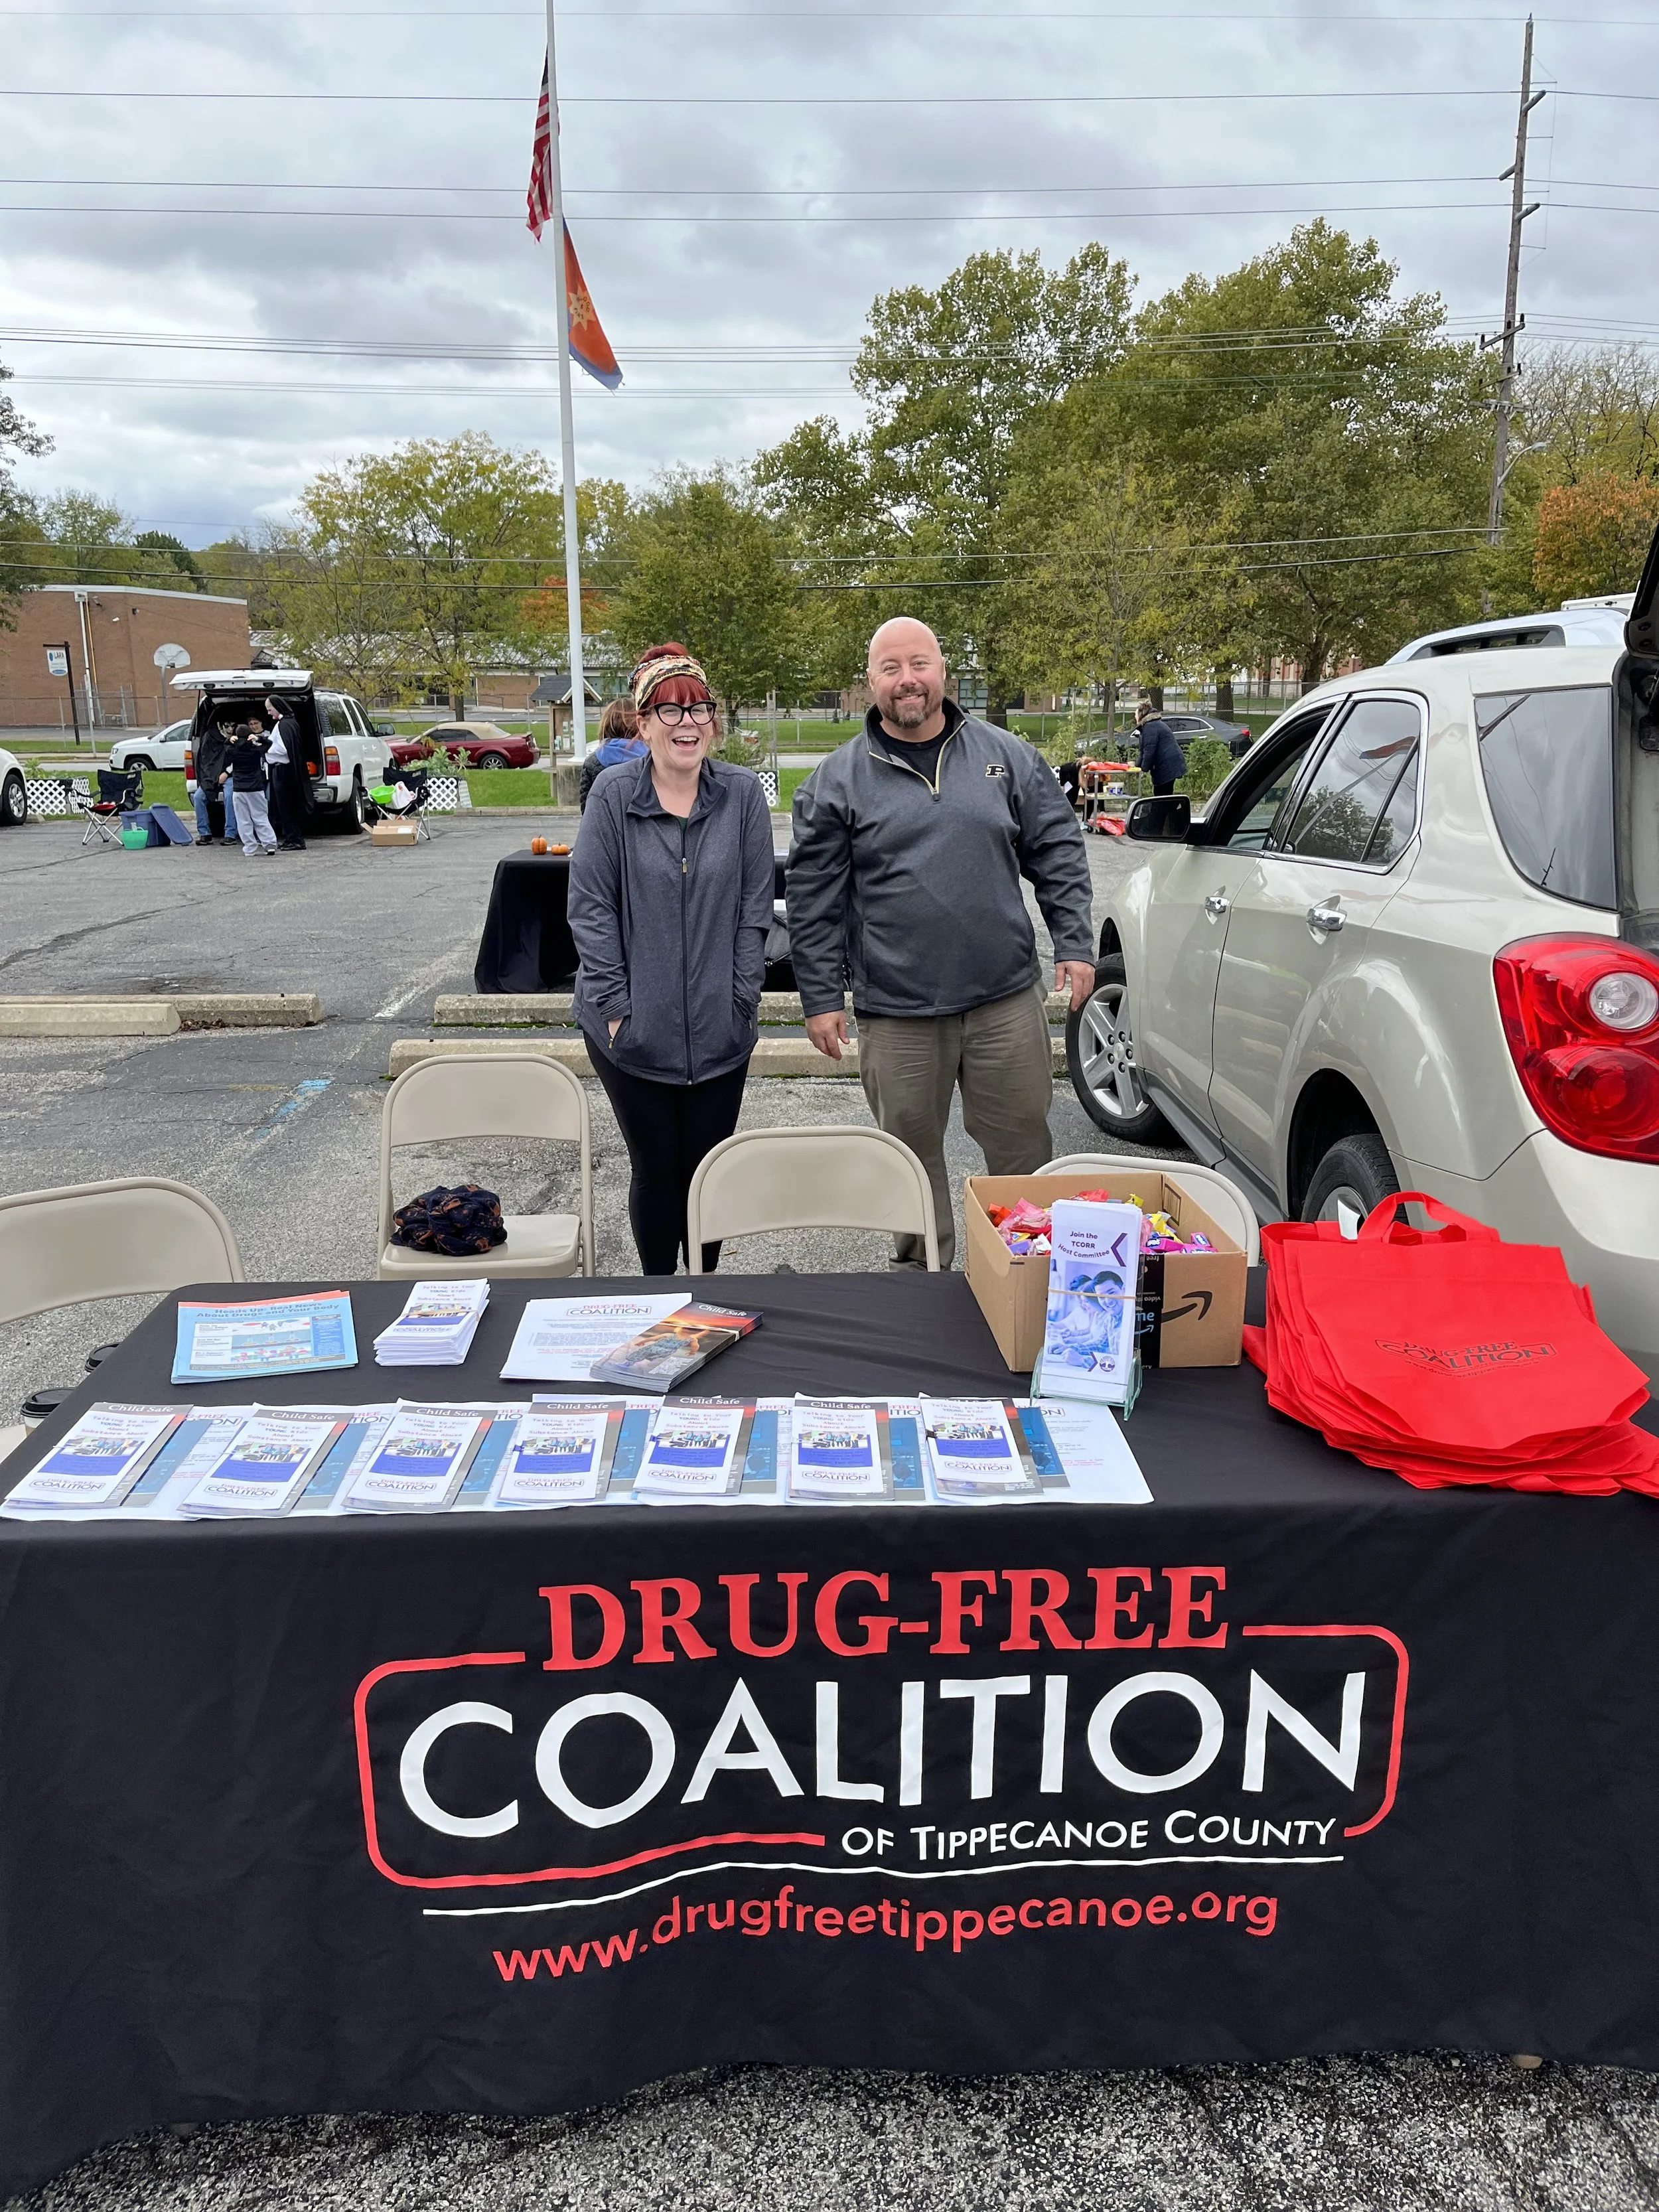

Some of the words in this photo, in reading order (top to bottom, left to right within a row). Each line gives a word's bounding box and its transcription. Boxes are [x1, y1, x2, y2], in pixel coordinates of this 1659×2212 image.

[985, 765, 1005, 777] P
[1058, 1243, 1072, 1255] Host
[1073, 1250, 1110, 1258] Committee
[1071, 1240, 1096, 1249] TCORR
[698, 1304, 726, 1315] Child
[725, 1308, 748, 1317] Safe
[1382, 1345, 1550, 1368] COALITION
[946, 1463, 1010, 1471] COALITION
[650, 1471, 715, 1481] COALITION
[804, 1472, 869, 1481] COALITION
[33, 1481, 102, 1490] COALITION
[208, 1487, 275, 1496] COALITION
[368, 1481, 435, 1490] COALITION
[539, 1567, 1228, 1670] DRUG-FREE
[400, 1669, 1366, 1837] COALITION
[842, 1828, 893, 1855] OF
[910, 1820, 1148, 1860] TIPPECANOE
[1165, 1810, 1336, 1845] COUNTY
[493, 1885, 1277, 1981] www.drugfreetippecanoe.org
